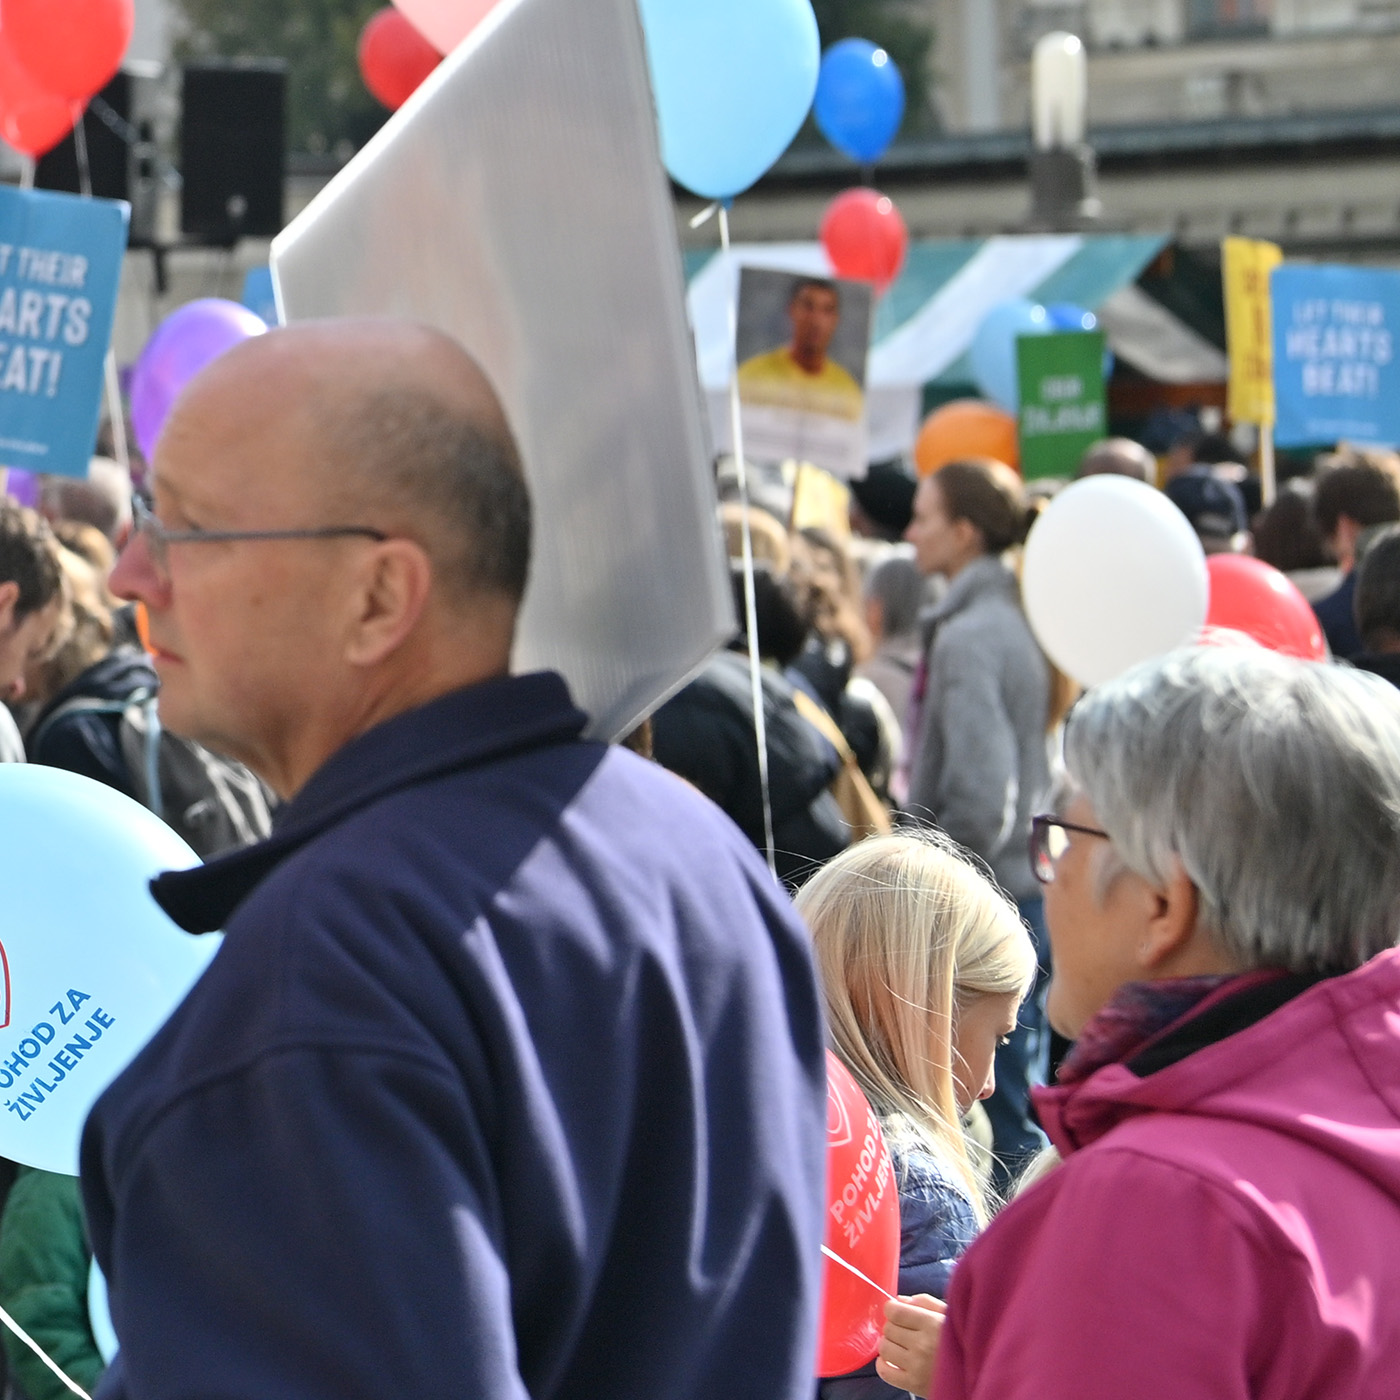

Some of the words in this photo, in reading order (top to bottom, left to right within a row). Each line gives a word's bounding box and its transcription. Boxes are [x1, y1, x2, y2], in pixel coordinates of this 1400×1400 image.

[16, 247, 90, 289] THEIR
[1285, 324, 1393, 366] HEARTS
[48, 988, 92, 1026] ZA
[3, 1006, 117, 1122] ŽIVLJENJE
[829, 1133, 878, 1226] POHOD
